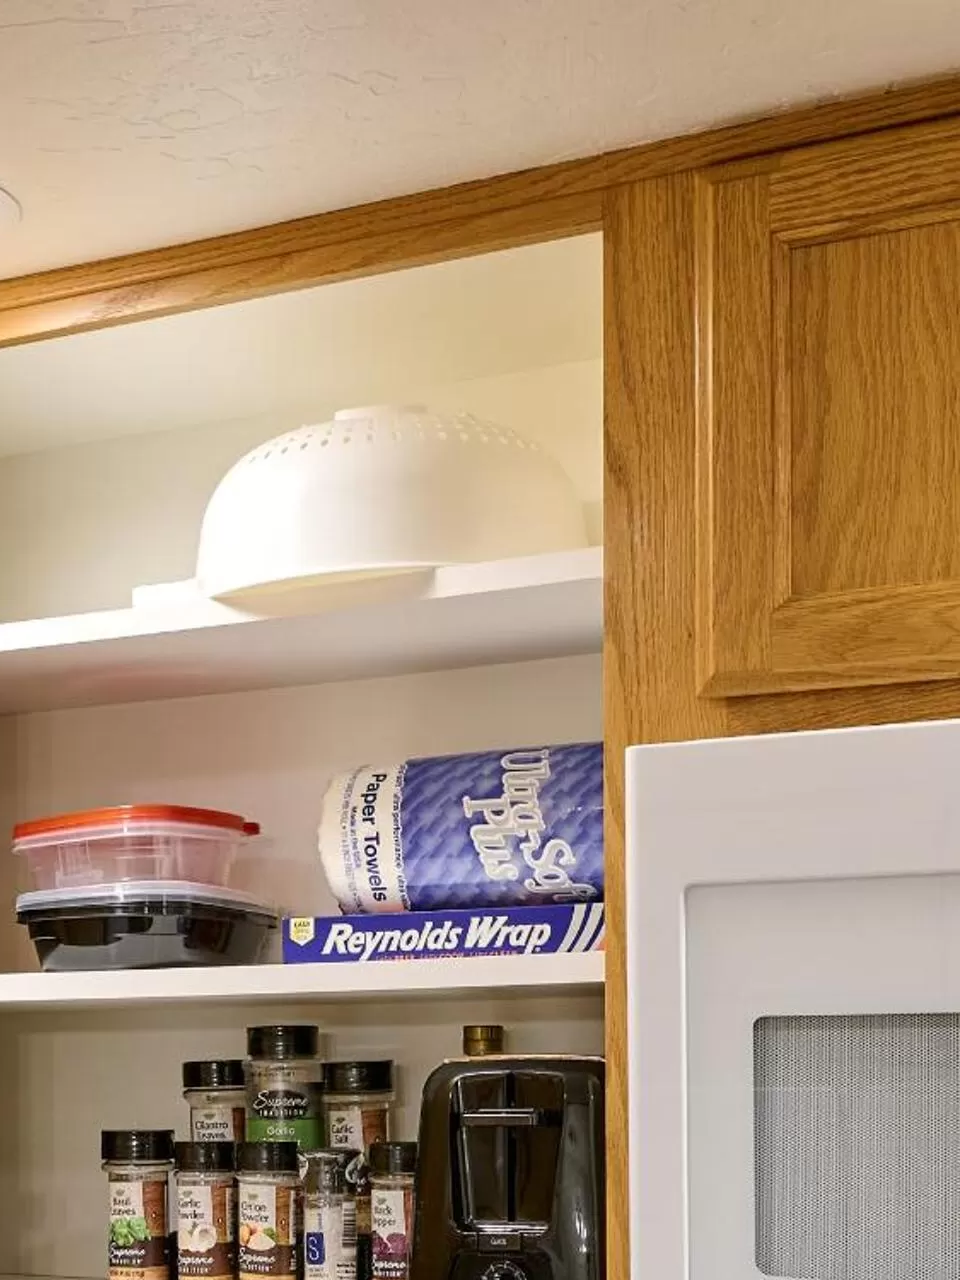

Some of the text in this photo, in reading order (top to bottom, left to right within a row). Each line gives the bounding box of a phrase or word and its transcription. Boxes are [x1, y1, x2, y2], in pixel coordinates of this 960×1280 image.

[361, 774, 387, 902] Paper Towels
[463, 796, 526, 881] Plus
[321, 921, 463, 961] Reynolds
[464, 916, 551, 956] Wrap
[253, 1090, 308, 1110] Supreme
[331, 1124, 354, 1134] Garlic
